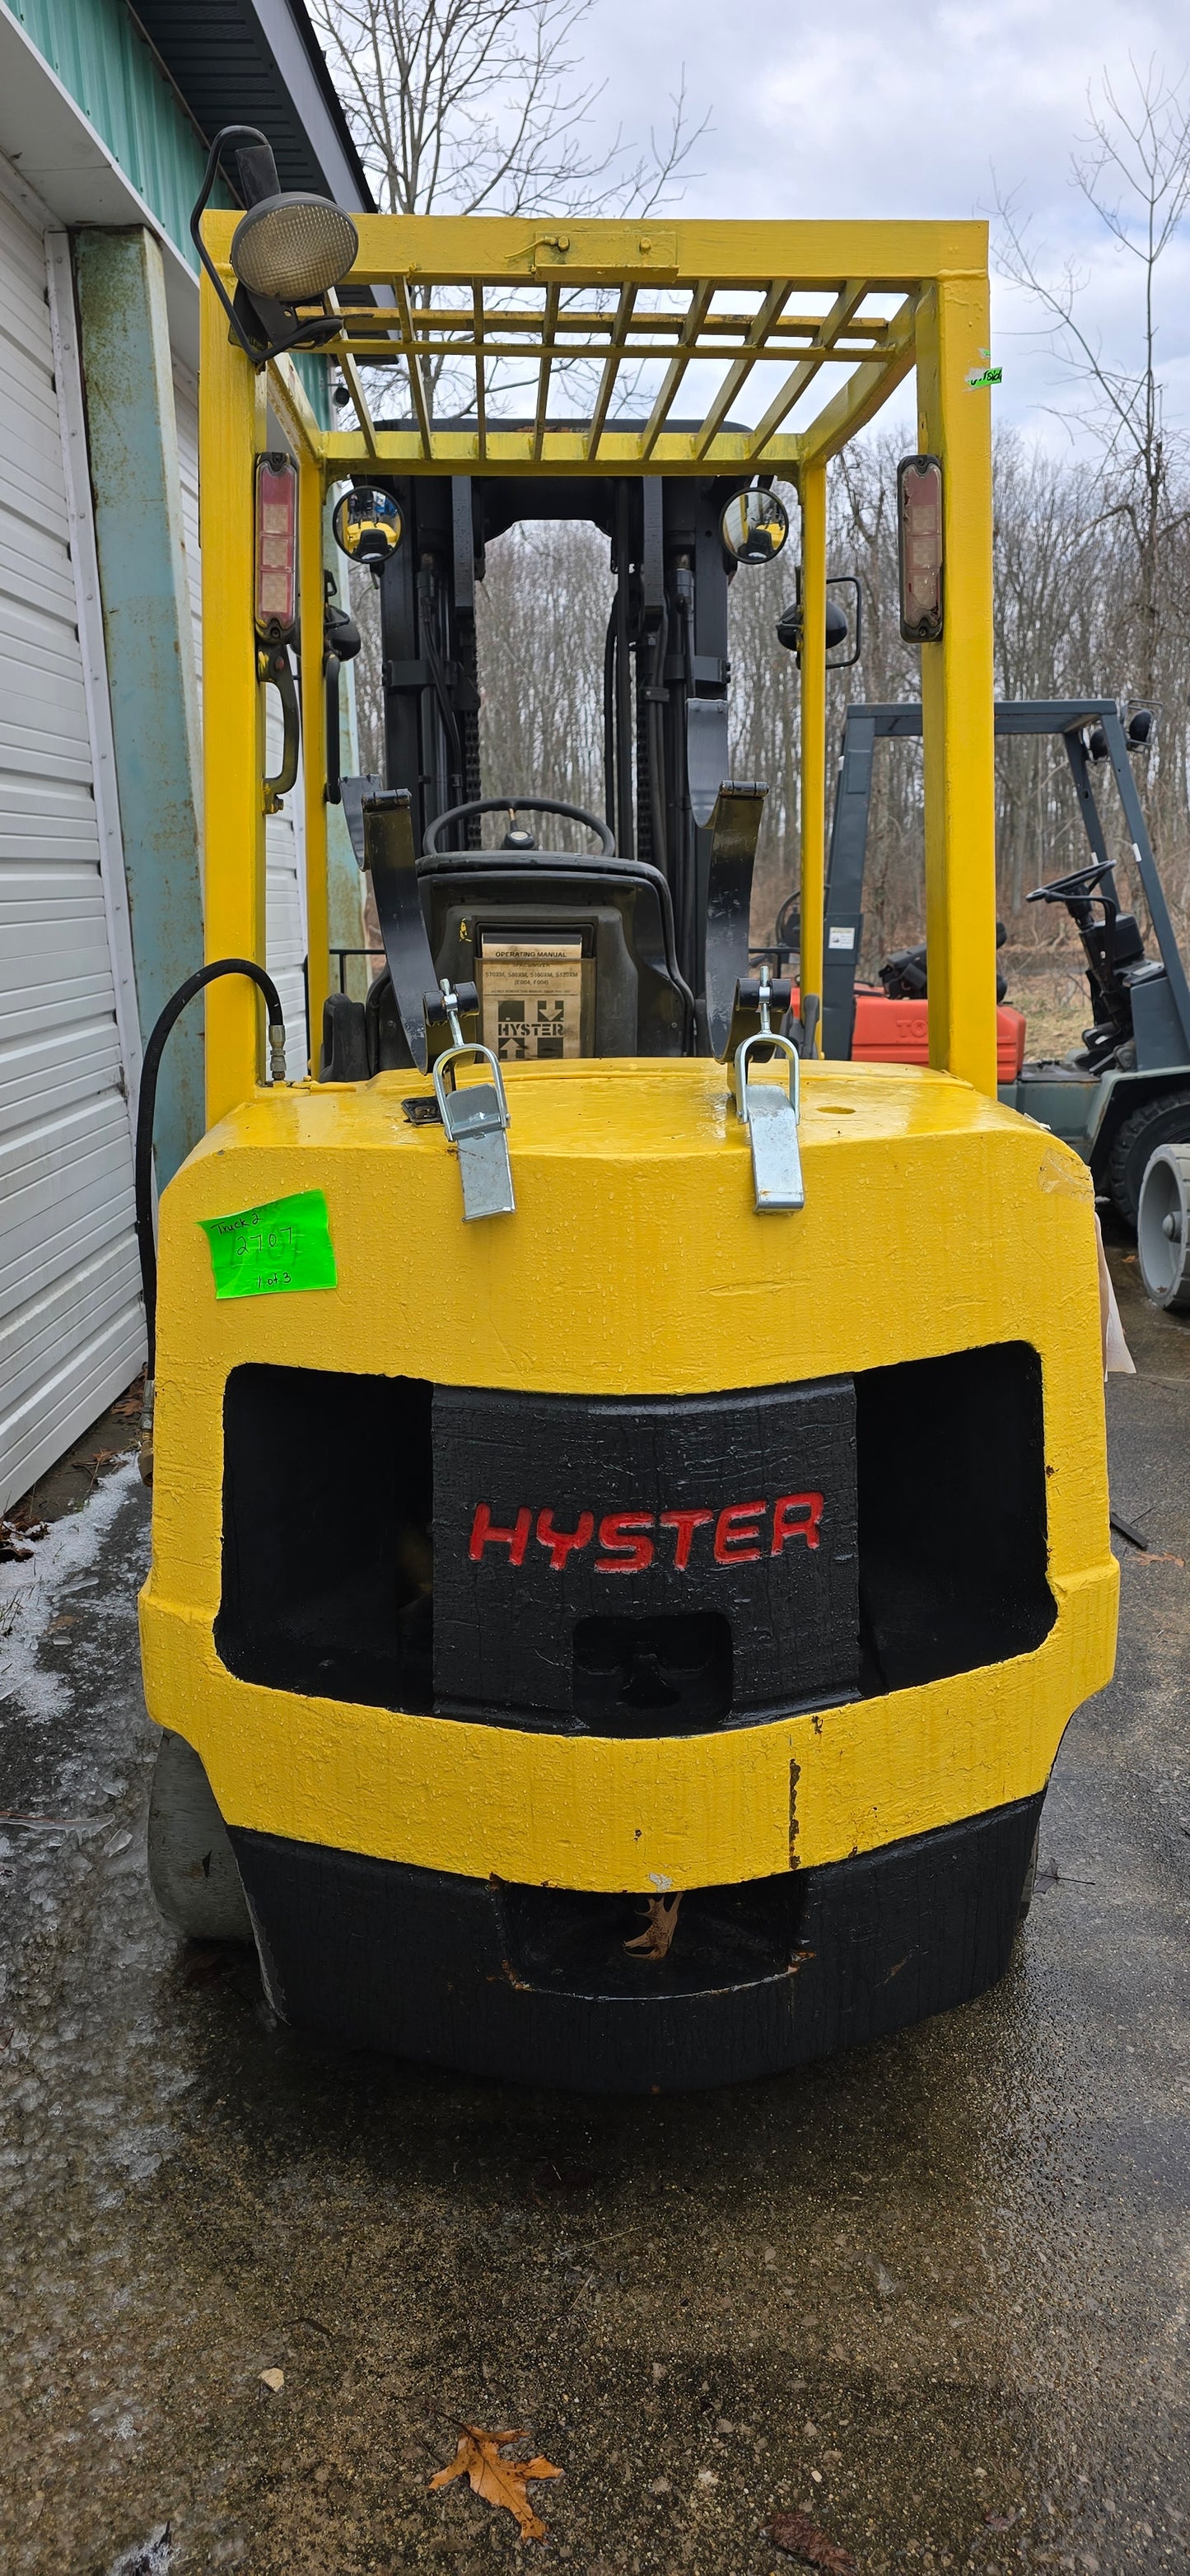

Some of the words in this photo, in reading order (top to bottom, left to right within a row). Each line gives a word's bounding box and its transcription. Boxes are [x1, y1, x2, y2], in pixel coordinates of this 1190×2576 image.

[497, 1023, 565, 1037] HYSTER
[210, 1218, 250, 1234] Truck
[251, 1212, 263, 1225] 2
[236, 1227, 293, 1256] 2707
[268, 1273, 278, 1286] of
[282, 1272, 292, 1284] 3
[469, 1492, 825, 1574] HYSTER
